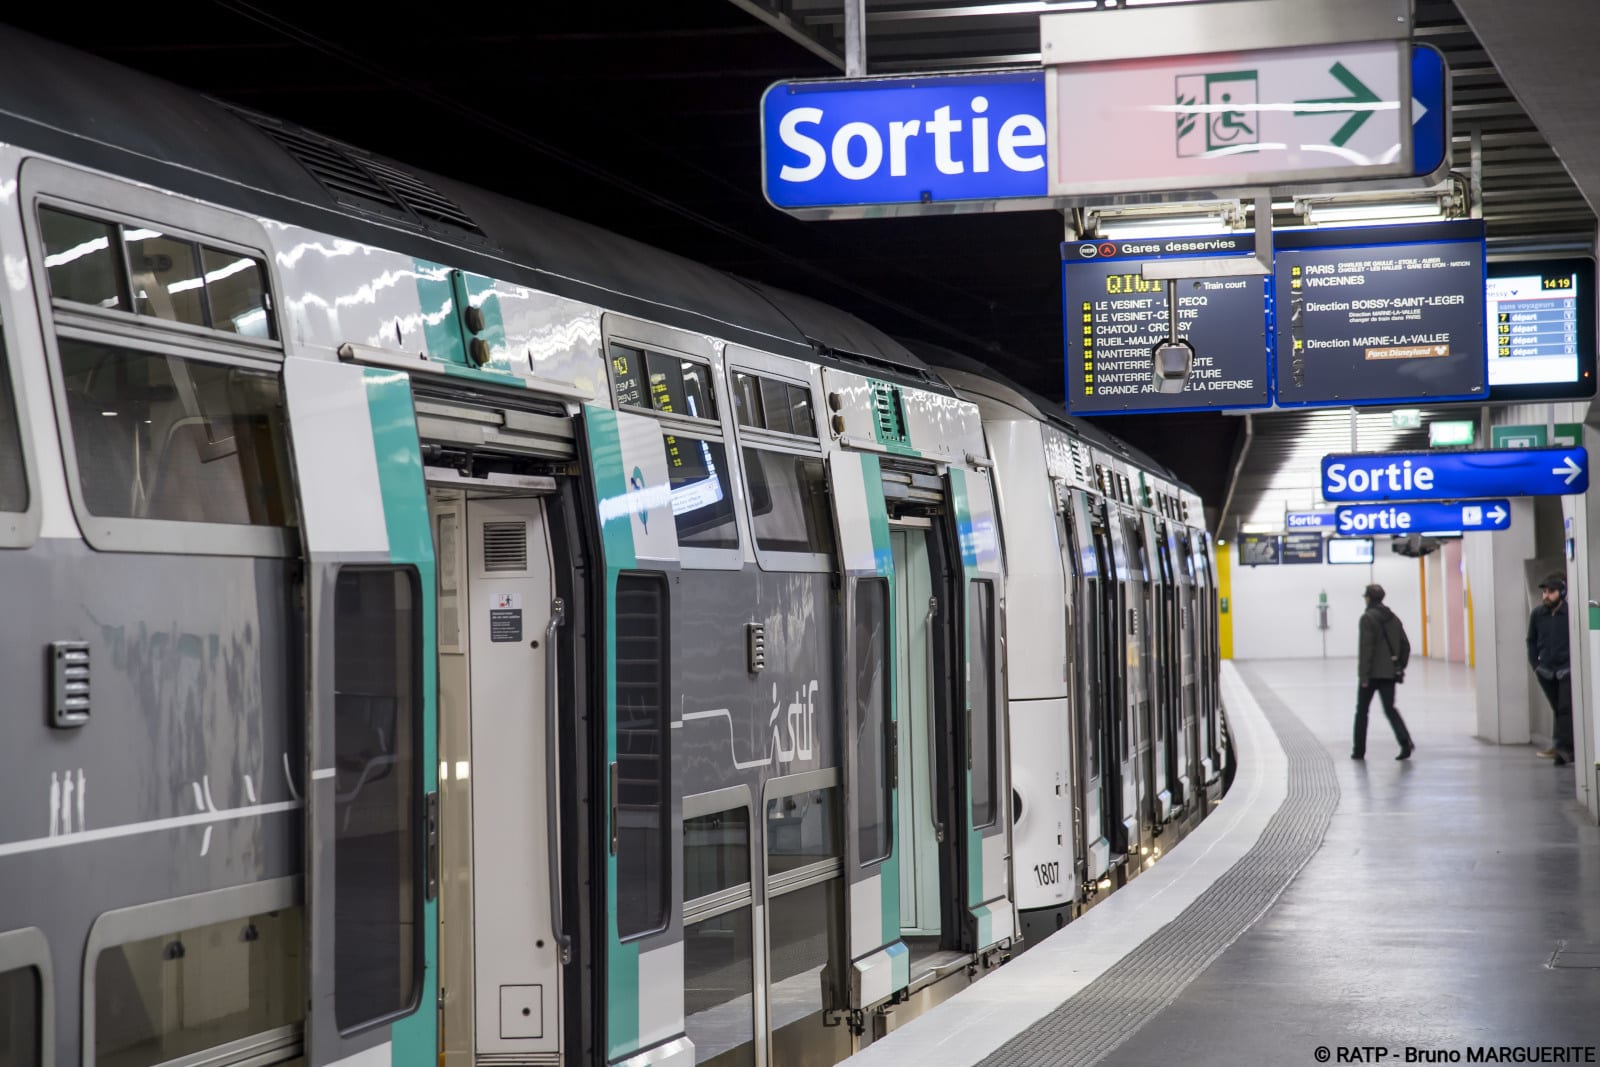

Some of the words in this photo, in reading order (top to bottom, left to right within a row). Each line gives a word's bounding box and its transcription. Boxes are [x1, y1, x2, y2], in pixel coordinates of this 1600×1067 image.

[779, 96, 1046, 182] Sortie
[1121, 243, 1160, 254] Gares
[1165, 240, 1236, 251] desservies
[1305, 264, 1335, 275] PARIS
[1203, 282, 1223, 291] Train
[1225, 281, 1247, 290] court
[1305, 275, 1365, 288] VINCENNES
[1544, 280, 1556, 288] 14
[1558, 279, 1570, 288] 19
[1095, 301, 1108, 310] LE
[1110, 298, 1152, 310] VESINET
[1178, 296, 1208, 306] PECQ
[1306, 301, 1349, 312] Direction
[1351, 294, 1465, 310] BOISSY-SAINT-LEGER
[1095, 313, 1109, 323] LE
[1500, 313, 1507, 321] 7
[1096, 324, 1138, 334] CHATOU
[1498, 324, 1509, 333] 15
[1307, 338, 1350, 349] Direction
[1352, 333, 1450, 347] MARNE-LA-VALLEE
[1498, 336, 1510, 345] 27
[1498, 347, 1510, 356] 35
[1098, 385, 1139, 395] GRANDE
[1193, 381, 1206, 391] LA
[1208, 379, 1254, 391] DEFENSE
[1327, 460, 1434, 493] Sortie
[1289, 513, 1322, 526] Sortie
[1339, 507, 1411, 530] Sortie
[1033, 862, 1060, 886] 1807
